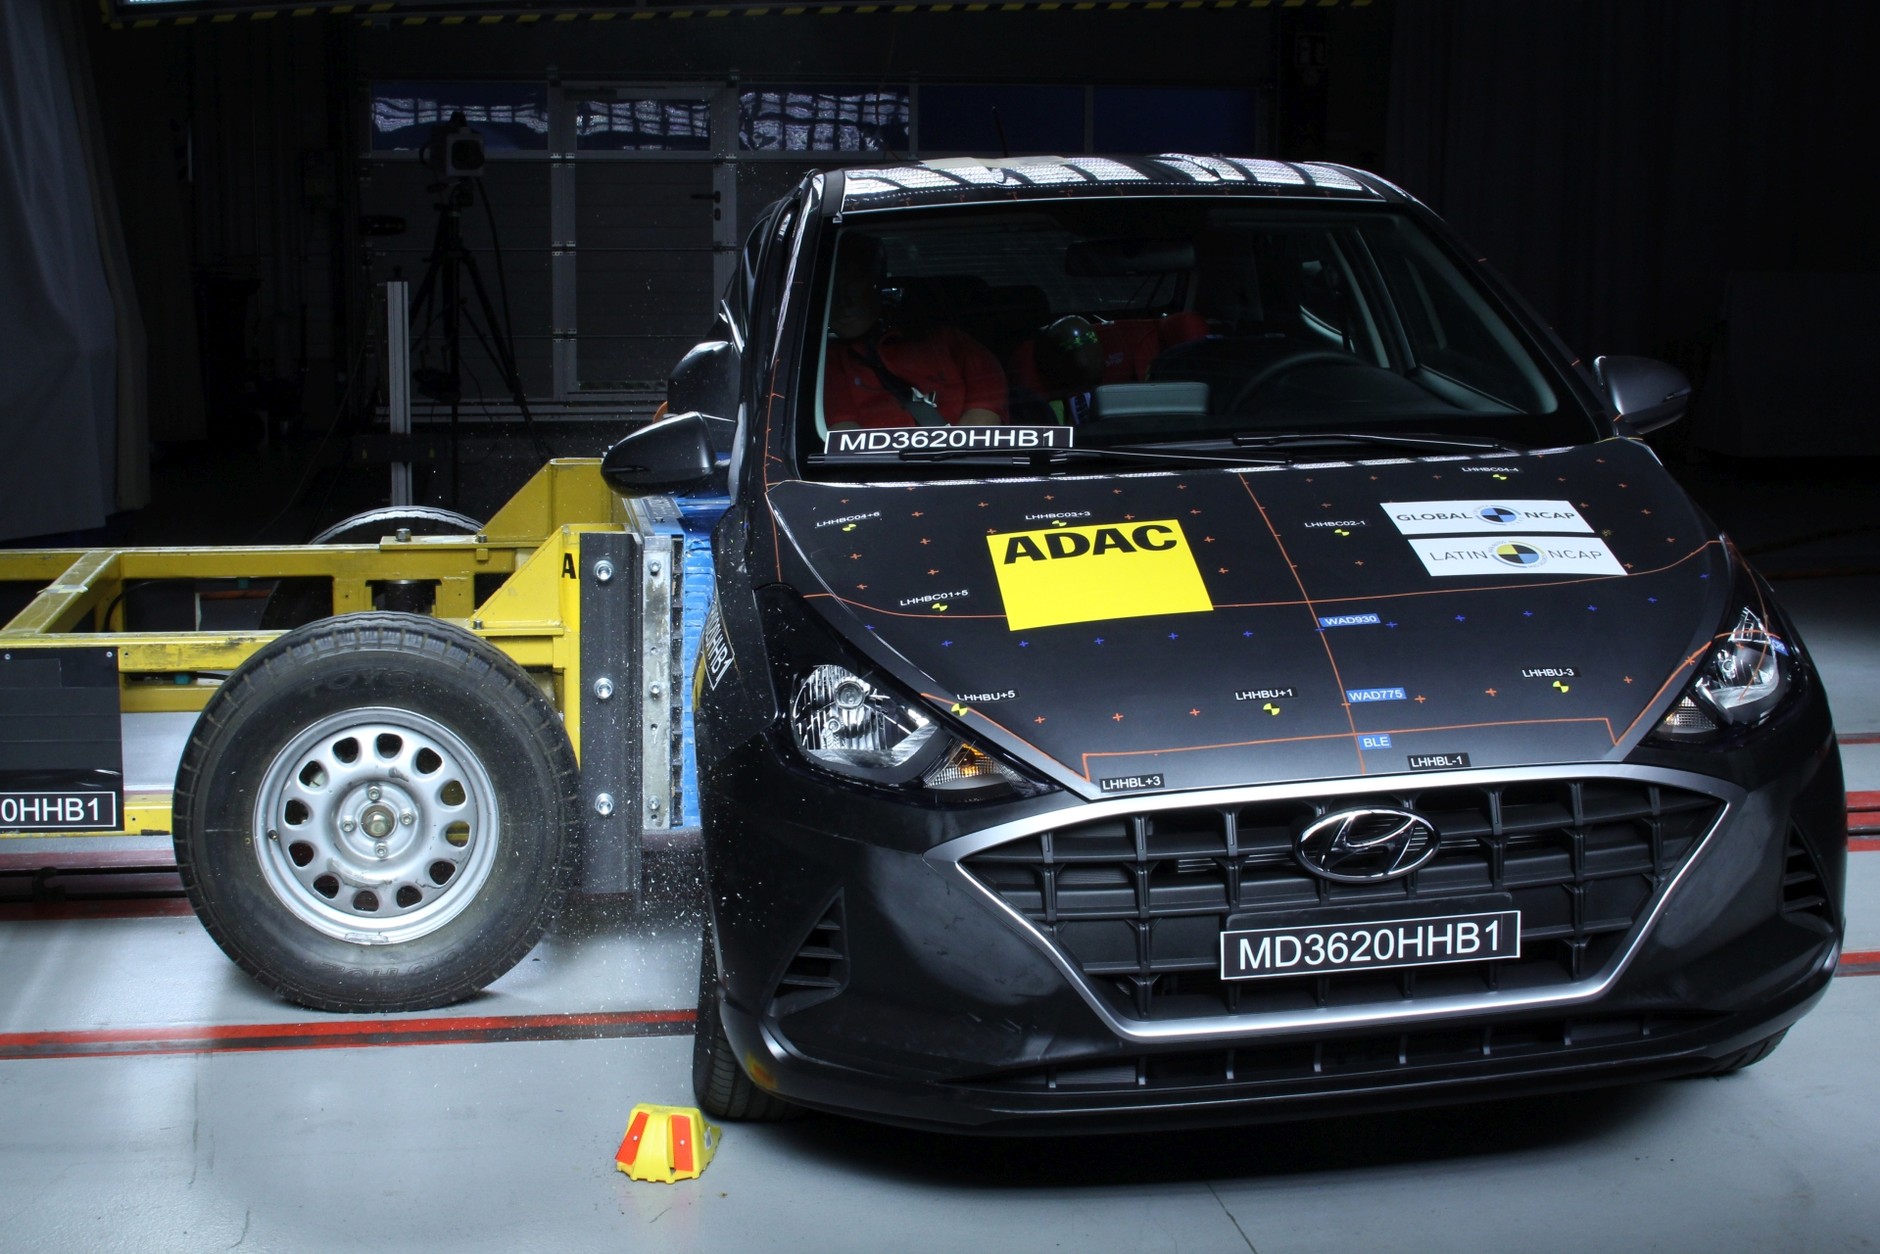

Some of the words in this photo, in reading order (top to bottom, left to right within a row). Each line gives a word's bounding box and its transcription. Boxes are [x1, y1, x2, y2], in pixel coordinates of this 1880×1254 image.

[839, 429, 1055, 451] MD3620HHB1
[816, 511, 880, 527] LHHBC04+6
[1396, 511, 1473, 521] GLOBAL
[1524, 511, 1576, 520] NCAP
[1304, 519, 1366, 528] LHHBC02-1
[1003, 524, 1178, 565] ADAC
[1429, 550, 1488, 561] LATIN
[1548, 549, 1602, 560] NCAP
[561, 552, 577, 580] A
[899, 589, 969, 607] LHHBC01+5
[1325, 615, 1377, 625] WAD930
[1521, 667, 1575, 678] LHHBU-3
[956, 689, 1016, 702] LHHBU+5
[1235, 688, 1293, 701] LHHBU+1
[1349, 689, 1403, 701] WAD775
[1363, 736, 1390, 748] BLE
[1410, 756, 1463, 768] LHHBL-1
[1101, 776, 1161, 791] LHHBL+3
[1, 797, 99, 823] 0HHB1
[1239, 919, 1499, 971] MD3620HHB1
